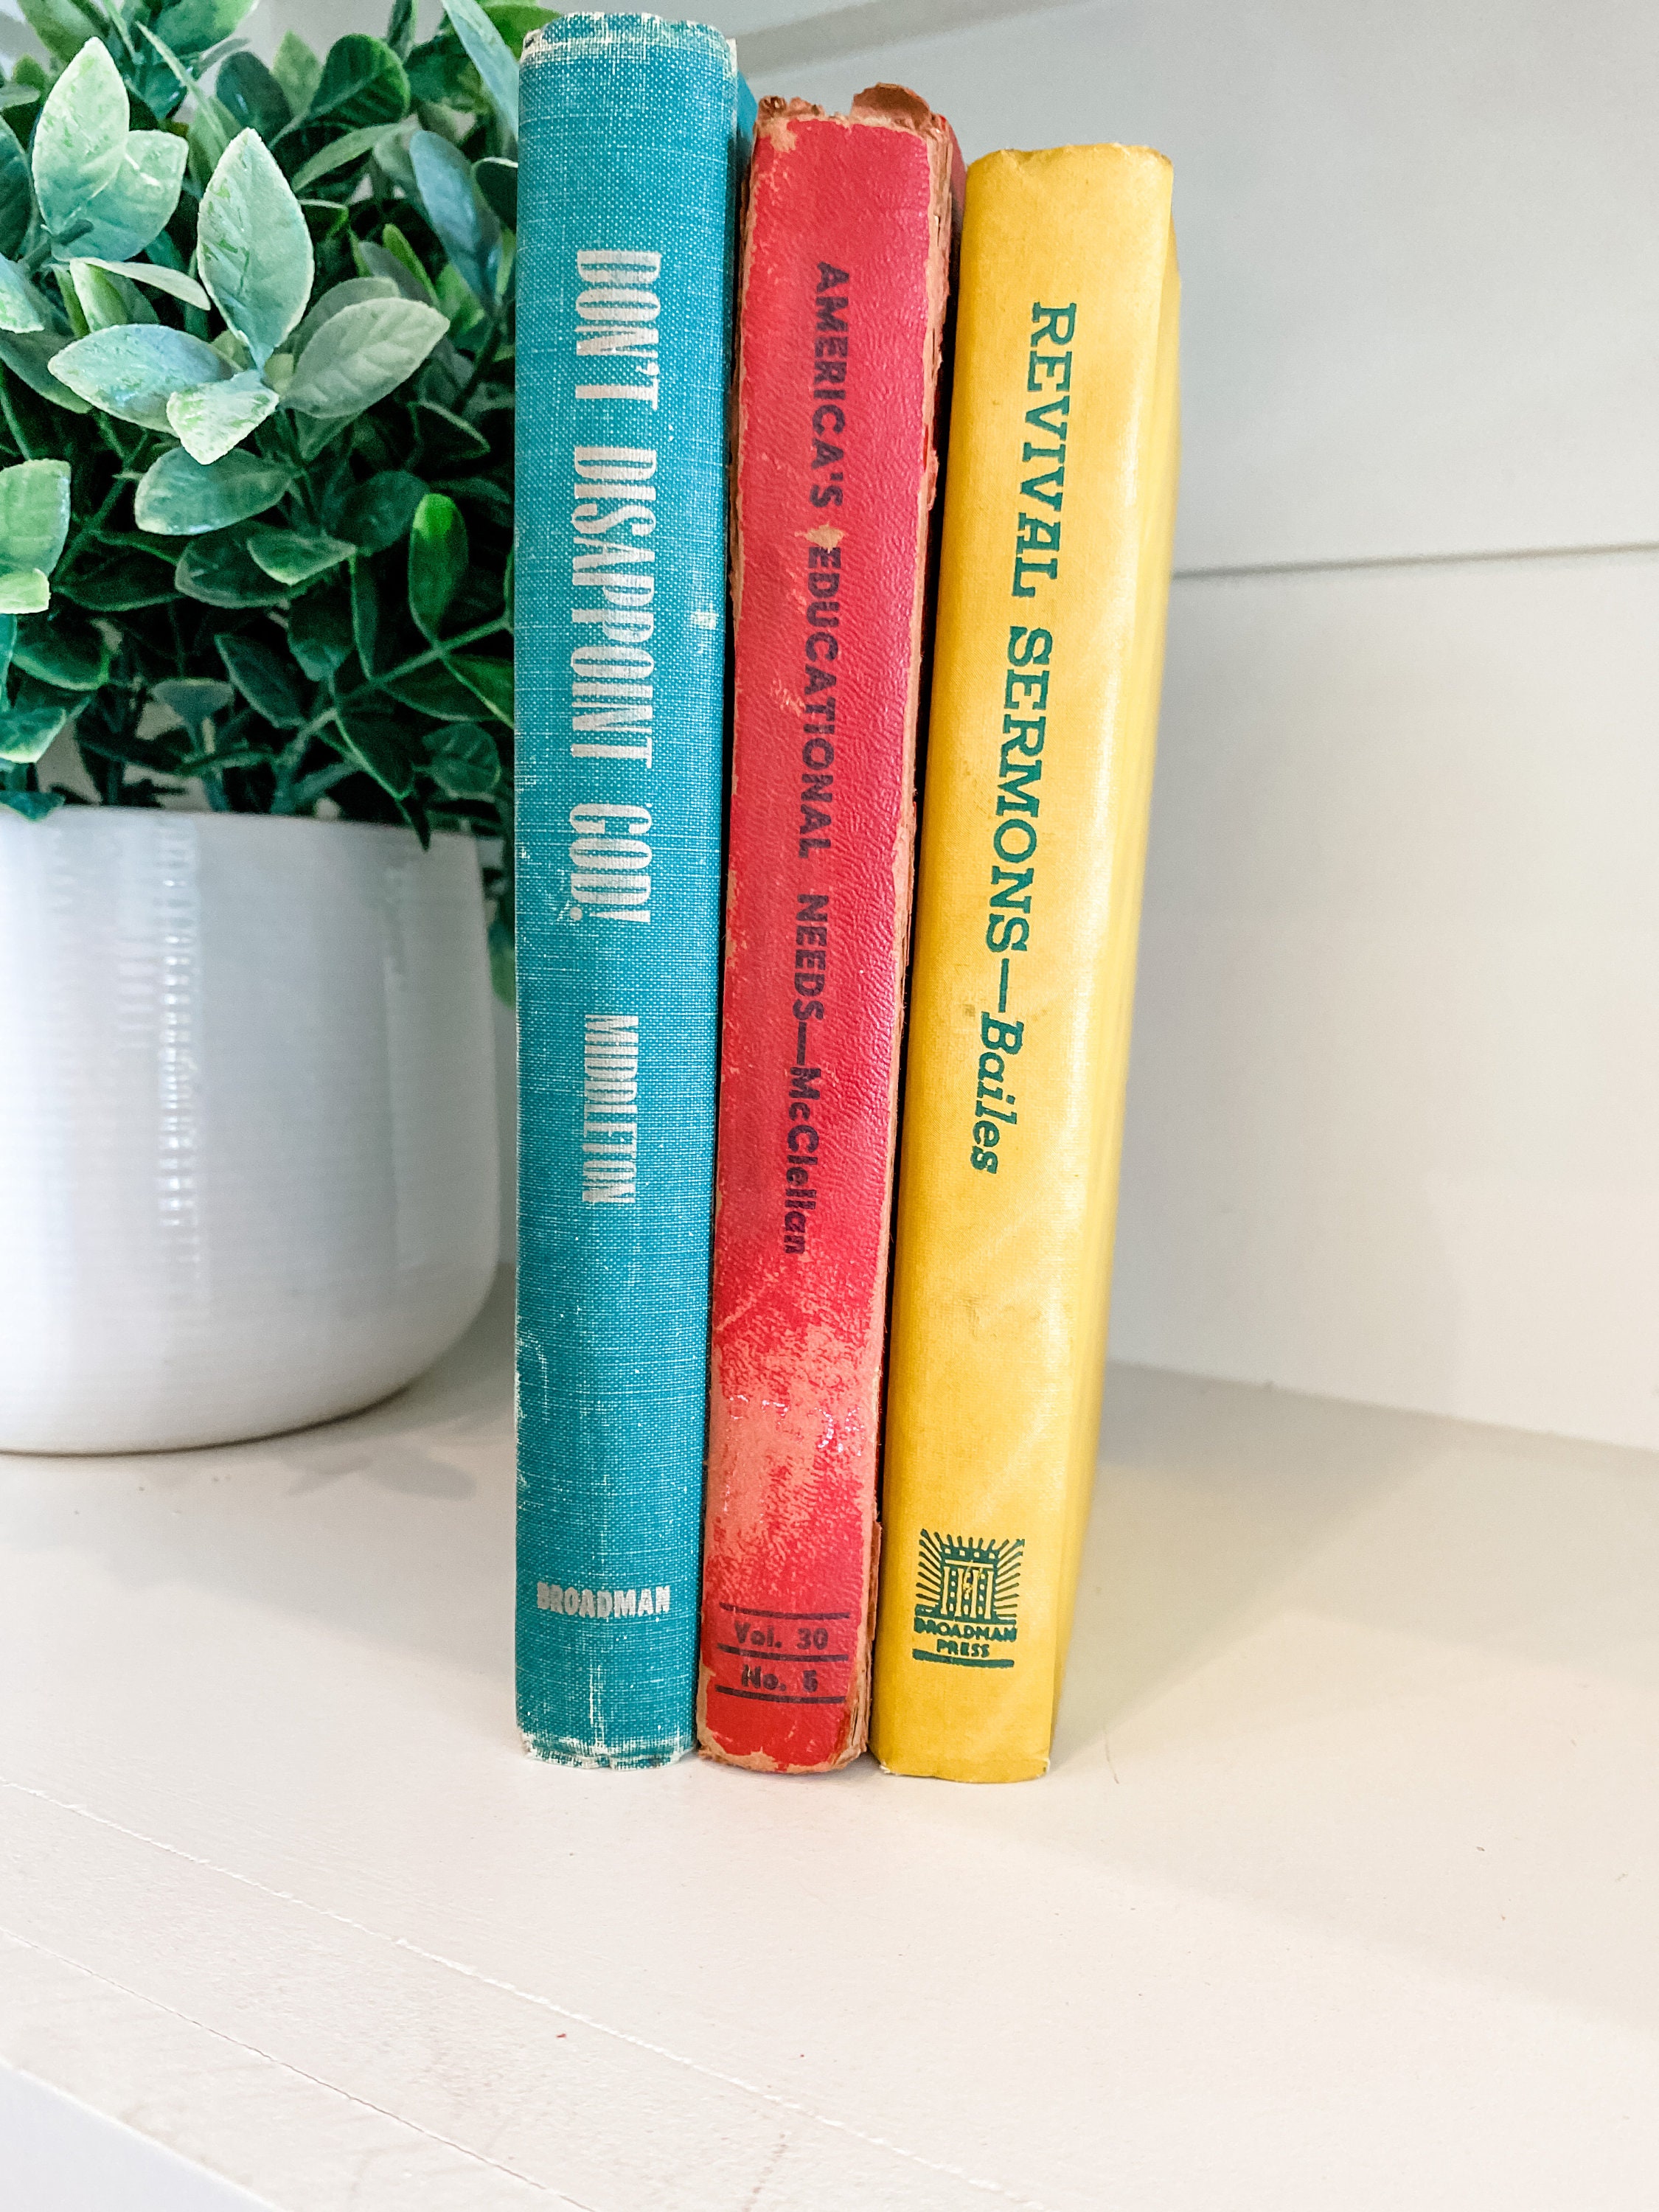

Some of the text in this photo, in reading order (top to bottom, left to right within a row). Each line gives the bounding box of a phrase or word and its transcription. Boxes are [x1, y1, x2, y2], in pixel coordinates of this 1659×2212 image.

[810, 261, 849, 508] AMERICA'S
[1012, 301, 1077, 598] REVIVAL
[569, 249, 662, 923] DON'T DISAPPOINT GOD!
[798, 546, 841, 859] EDUCATIONAL
[582, 1014, 639, 1203] MIDDLETON
[536, 1581, 670, 1618] BROADMAN
[734, 1621, 829, 1650] Vol. 30
[914, 1616, 1018, 1643] BROADMAN
[936, 1638, 990, 1658] PRESS
[740, 1663, 787, 1692] No.
